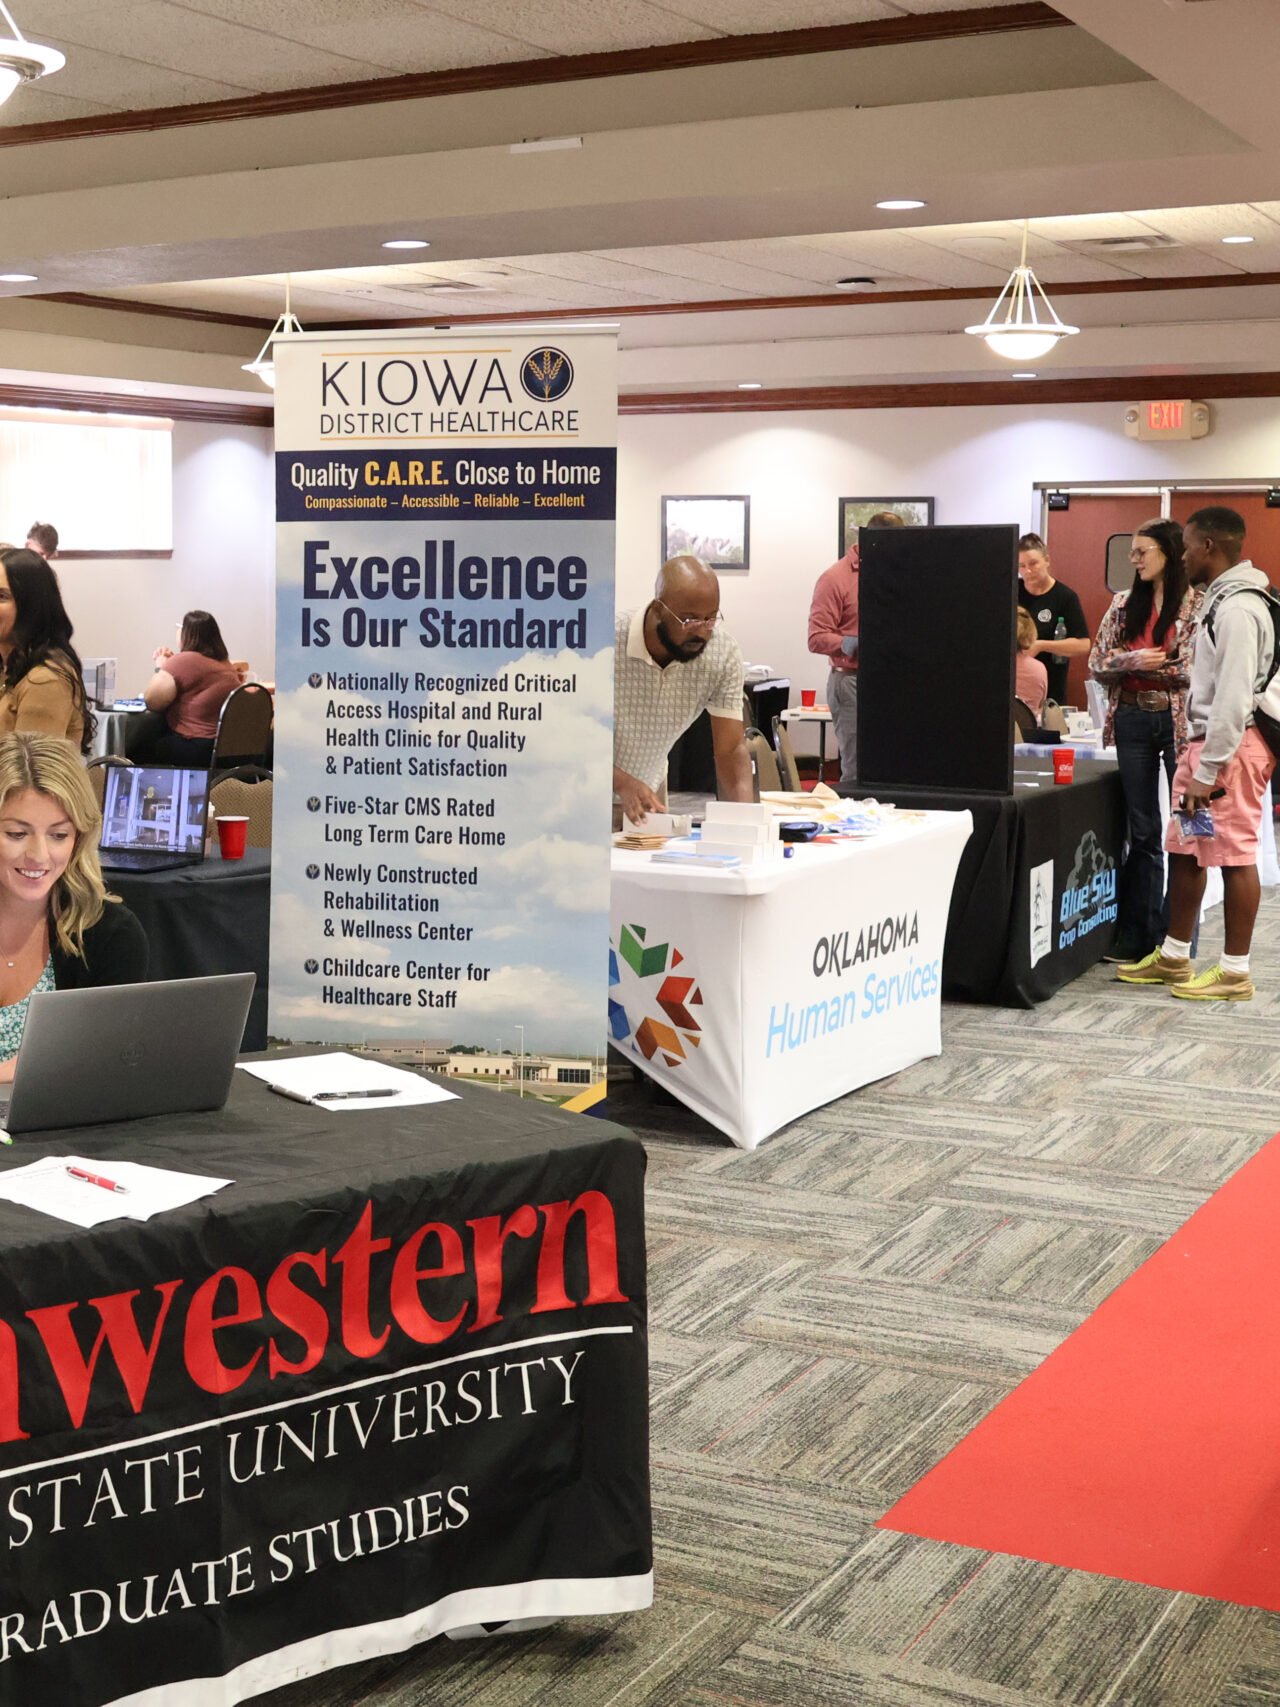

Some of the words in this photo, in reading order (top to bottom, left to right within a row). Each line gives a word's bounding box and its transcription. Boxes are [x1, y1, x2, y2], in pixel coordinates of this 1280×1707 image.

[322, 359, 512, 407] KIOWA
[320, 413, 422, 434] DISTRICT
[430, 410, 579, 432] HEALTHCARE
[1149, 402, 1184, 429] EXIT
[291, 462, 358, 490] Quality
[364, 460, 449, 486] C.A.R.E.
[456, 460, 509, 485] Close
[516, 462, 535, 485] to
[542, 459, 601, 485] Home
[305, 496, 387, 510] Compassionate
[402, 494, 459, 508] Accessible
[474, 494, 519, 508] Reliable
[534, 494, 585, 507] Excellent
[304, 540, 587, 600] Excellence
[302, 608, 330, 647] Is
[342, 607, 407, 648] Our
[420, 607, 586, 649] Standard
[326, 671, 408, 694] Nationally
[415, 672, 508, 695] Recognized
[515, 673, 576, 693] Critical
[326, 701, 381, 719] Access
[387, 701, 456, 723] Hospital
[462, 702, 491, 720] and
[498, 702, 542, 721] Rural
[326, 728, 379, 748] Health
[385, 729, 432, 748] Clinic
[438, 730, 461, 749] for
[467, 731, 526, 752] Quality
[326, 756, 337, 775] &
[343, 756, 402, 776] Patient
[408, 757, 507, 777] Satisfaction
[325, 796, 399, 815] Five-Star
[404, 797, 440, 816] CMS
[447, 798, 495, 817] Rated
[324, 824, 362, 846] Long
[368, 824, 409, 844] Term
[415, 826, 452, 845] Care
[458, 827, 506, 846] Home
[324, 864, 371, 885] Newly
[377, 865, 478, 885] Constructed
[324, 890, 439, 912] Rehabilitation
[1060, 885, 1089, 922] Blue
[1091, 869, 1116, 903] Sky
[323, 919, 335, 937] &
[341, 919, 412, 939] Wellness
[418, 922, 473, 941] Center
[1059, 928, 1076, 950] Crop
[1078, 903, 1117, 938] Consulting
[813, 910, 919, 977] OKLAHOMA
[323, 958, 400, 979] Childcare
[406, 960, 461, 980] Center
[467, 962, 490, 981] for
[322, 986, 411, 1006] Healthcare
[417, 989, 457, 1008] Staff
[766, 989, 856, 1058] Human
[861, 956, 938, 1019] Services
[8, 1444, 205, 1550] STATE
[227, 1350, 585, 1484] UNIVERSITY
[269, 1485, 472, 1584] STUDIES
